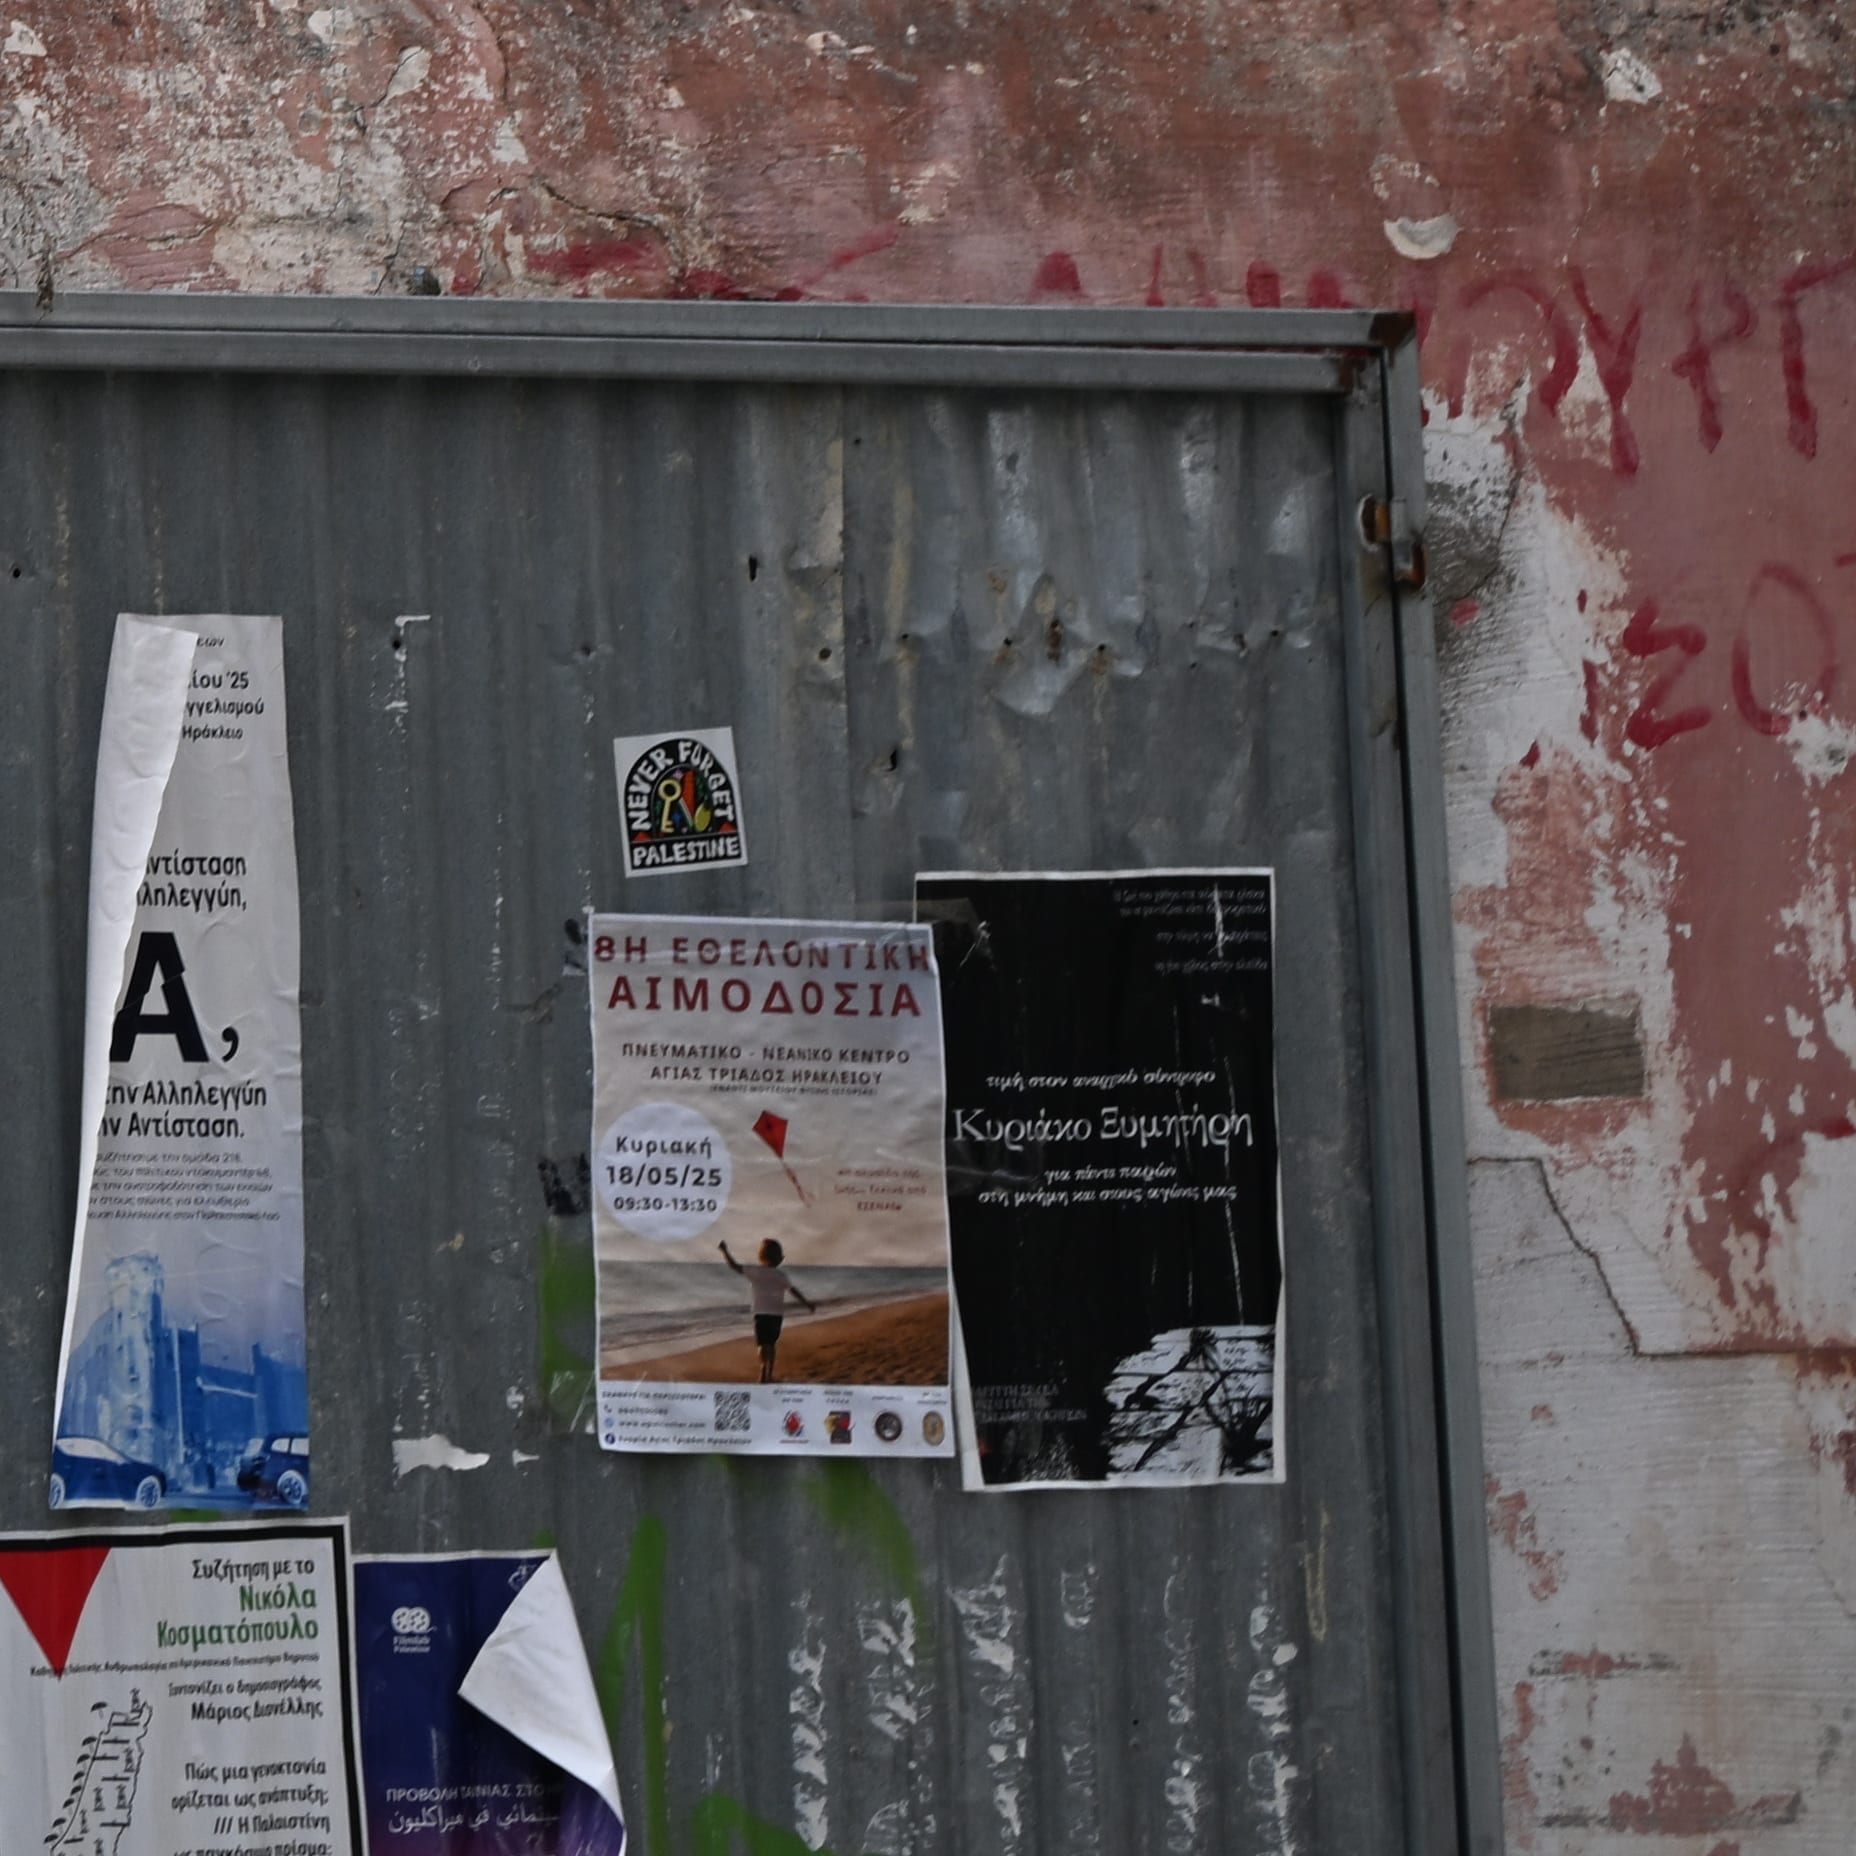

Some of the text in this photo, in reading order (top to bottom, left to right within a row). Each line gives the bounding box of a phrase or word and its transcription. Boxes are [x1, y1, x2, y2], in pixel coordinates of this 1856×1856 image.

[627, 740, 735, 832] NEVER FORGET
[145, 848, 248, 876] ντίσταση
[632, 835, 740, 867] PALESTINE
[593, 935, 931, 972] 8Η ΕΘΕΛΟΝΤΙΚΗ
[607, 975, 921, 1018] ΑΙΜΟΔΟΣΙΑ
[621, 1043, 911, 1064] ΠΝΕΥΜΑΤΙΚΟ ΝΕΑΝΙΚΟ ΚΕΝΤΡΟ
[649, 1067, 883, 1086] ΑΓΙΑΣ ΤΡΙΑΔΟΣ ΗΡΑΚΛΕΙΟΥ
[985, 1071, 1025, 1092] τιμή
[142, 1080, 267, 1111] Αλληλεγγύη
[127, 1110, 245, 1139] Αντίσταση.
[952, 1102, 1254, 1152] Κυριάκο Ξυμητήρη
[615, 1135, 713, 1157] Κυριακή
[605, 1164, 723, 1188] 18/05/25
[613, 1196, 718, 1212] 09:30-13:30
[1014, 1187, 1068, 1207] μνήμη
[191, 1558, 315, 1583] Συζήτηση με το
[238, 1582, 318, 1613] Νικόλα
[156, 1612, 320, 1653] Κοσματόπουλο
[225, 1685, 235, 1695] ο
[190, 1700, 252, 1725] Μάριος
[184, 1760, 327, 1784] Πώς μια γενοκτονία
[170, 1791, 230, 1810] ορίζεται
[233, 1792, 258, 1809] ως
[385, 1787, 460, 1803] ΠΡΟΒΟΛΗ
[237, 1817, 250, 1834] Η
[251, 1813, 331, 1834] Παλαιστίνη
